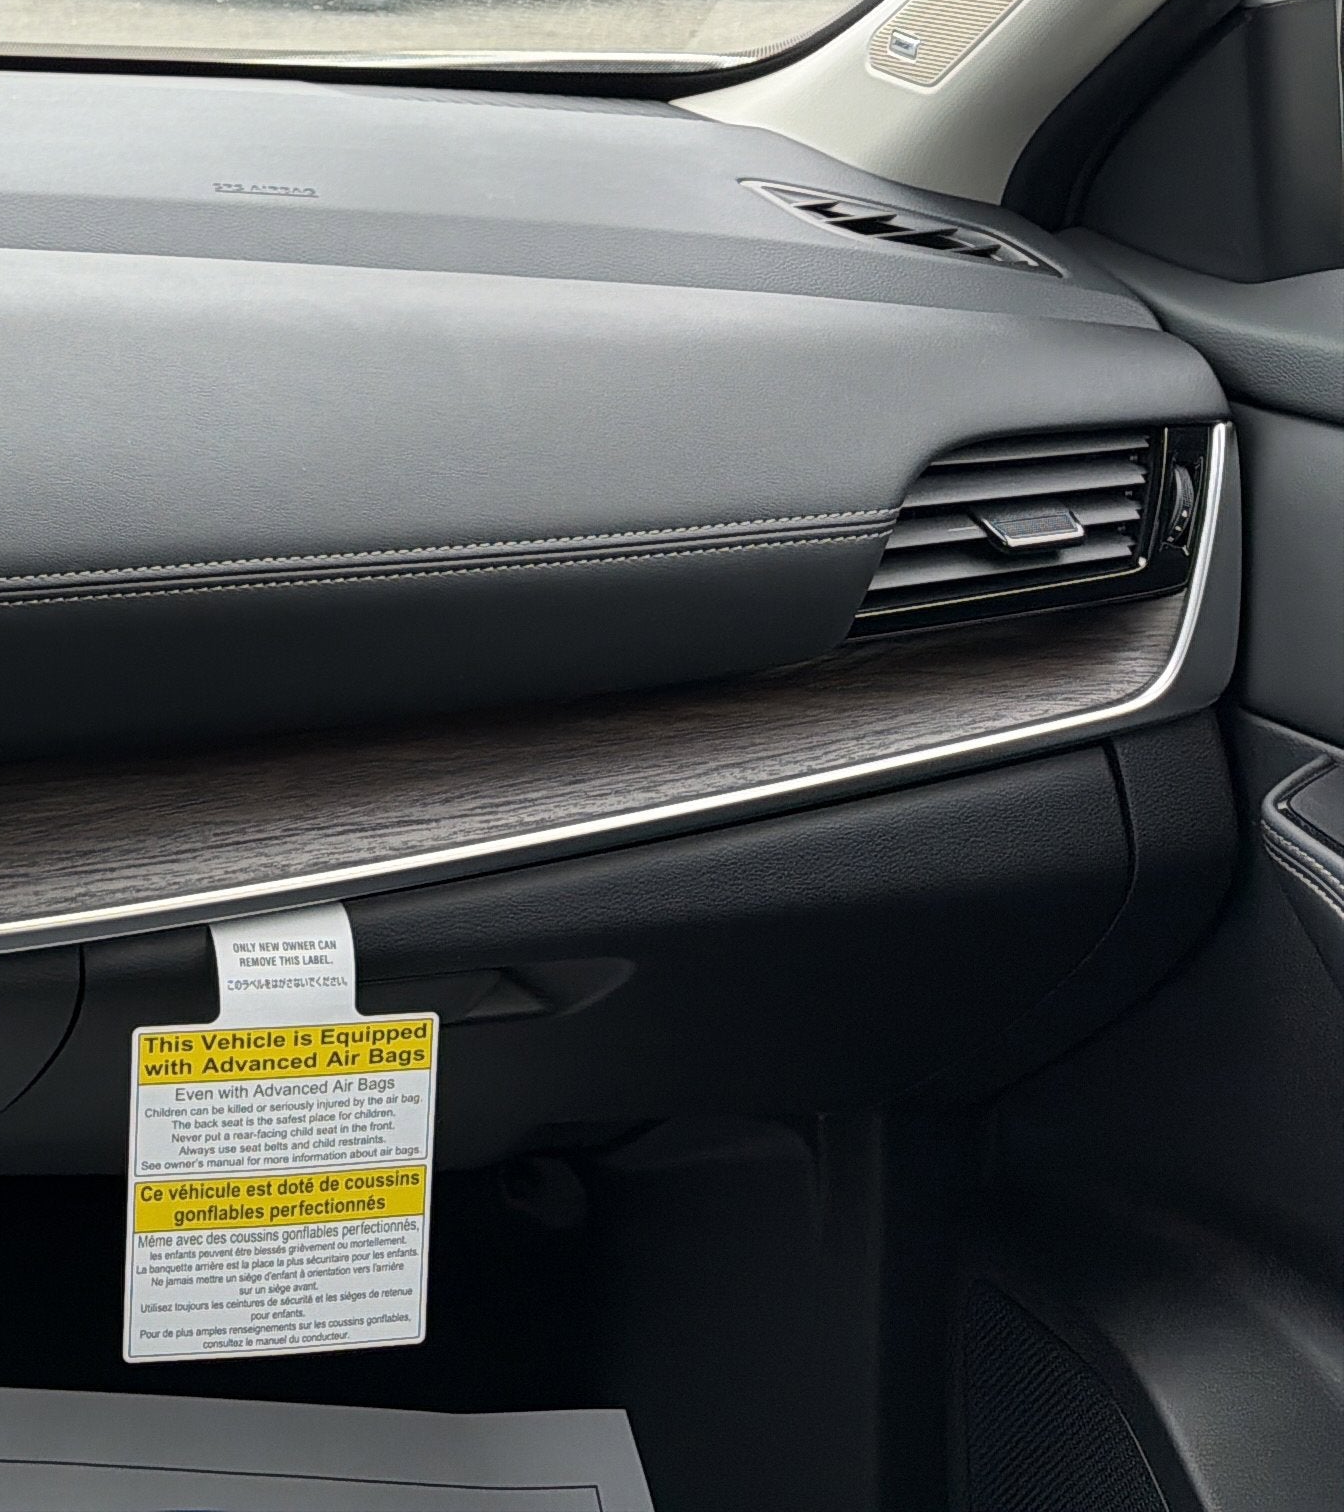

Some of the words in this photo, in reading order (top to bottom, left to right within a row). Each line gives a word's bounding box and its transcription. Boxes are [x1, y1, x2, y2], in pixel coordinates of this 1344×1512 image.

[232, 943, 256, 953] ONLY
[258, 942, 279, 952] NEW
[281, 941, 316, 951] OWNER
[317, 940, 336, 950] CAN
[238, 957, 277, 967] REMOVE
[278, 956, 300, 966] THIS
[302, 955, 333, 965] LABEL.
[144, 1036, 193, 1053] This
[201, 1031, 285, 1051] Vehicle
[293, 1028, 312, 1046] is
[320, 1024, 427, 1046] Equipped
[144, 1059, 192, 1076] with
[201, 1053, 317, 1073] Advanced
[326, 1050, 360, 1066] Air
[369, 1046, 425, 1067] Bags
[175, 1088, 213, 1101] Even
[217, 1085, 248, 1099] with
[252, 1081, 328, 1097] Advanced
[332, 1079, 353, 1093] Air
[358, 1076, 395, 1093] Bags
[141, 1186, 163, 1202] Ce
[169, 1180, 241, 1200] véhicule
[247, 1182, 273, 1197] est
[277, 1176, 315, 1195] doté
[319, 1176, 339, 1192] de
[345, 1171, 420, 1190] coussins
[174, 1204, 264, 1226] gonflables
[270, 1196, 385, 1220] perfectionnés
